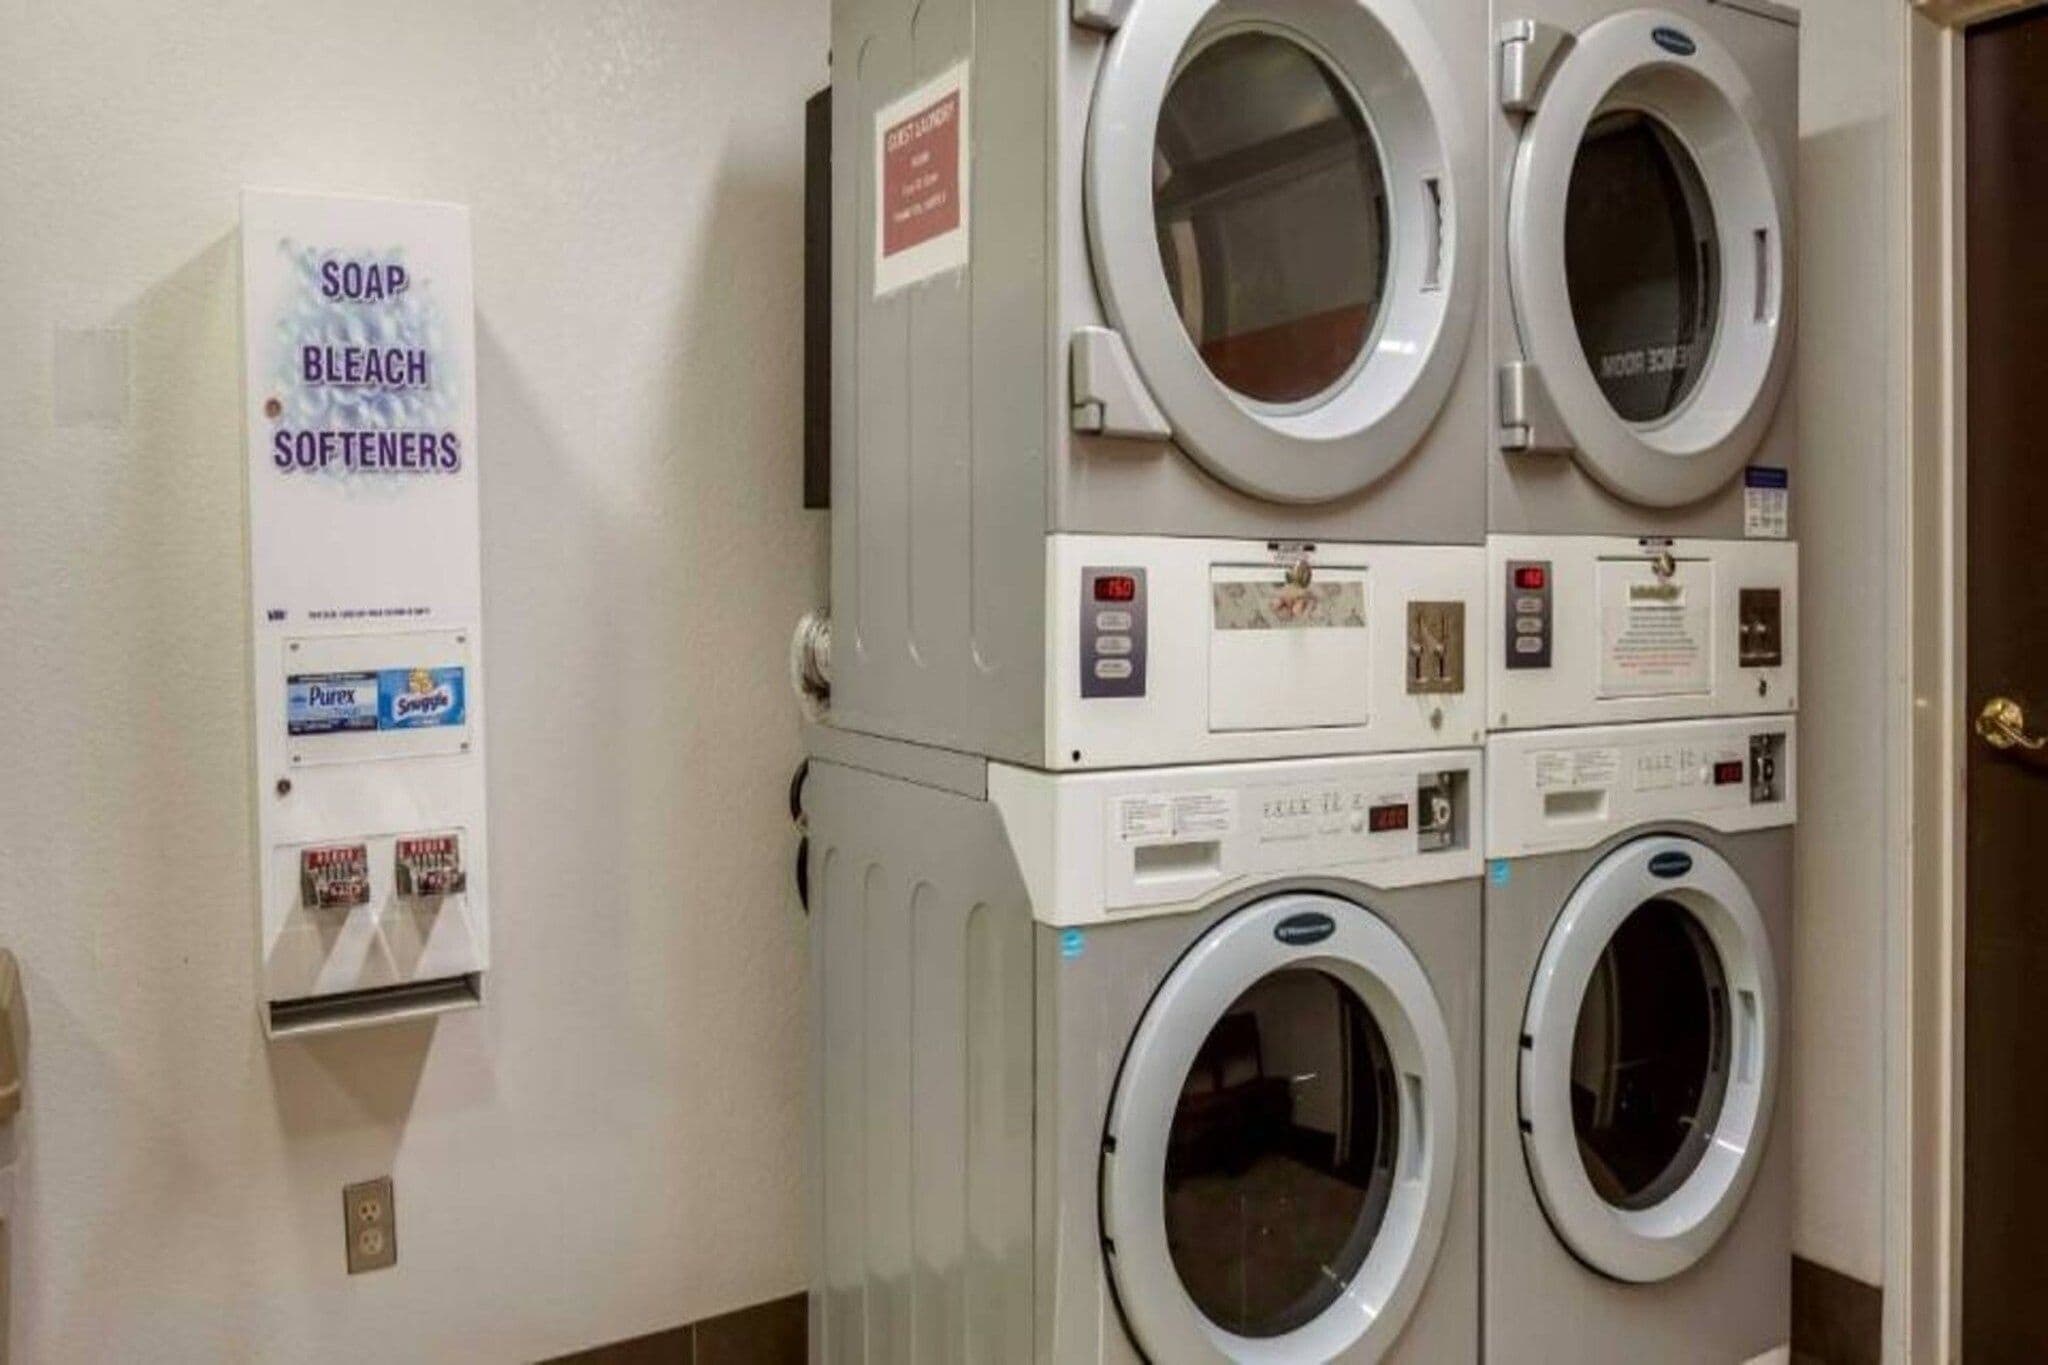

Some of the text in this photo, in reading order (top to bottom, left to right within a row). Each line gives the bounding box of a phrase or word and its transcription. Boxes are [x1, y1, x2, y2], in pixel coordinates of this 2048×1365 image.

[321, 260, 406, 300] SOAP
[302, 346, 427, 385] BLEACH
[273, 430, 459, 470] SOFTENERS
[309, 685, 356, 707] Purex
[397, 690, 449, 716] Snuggle
